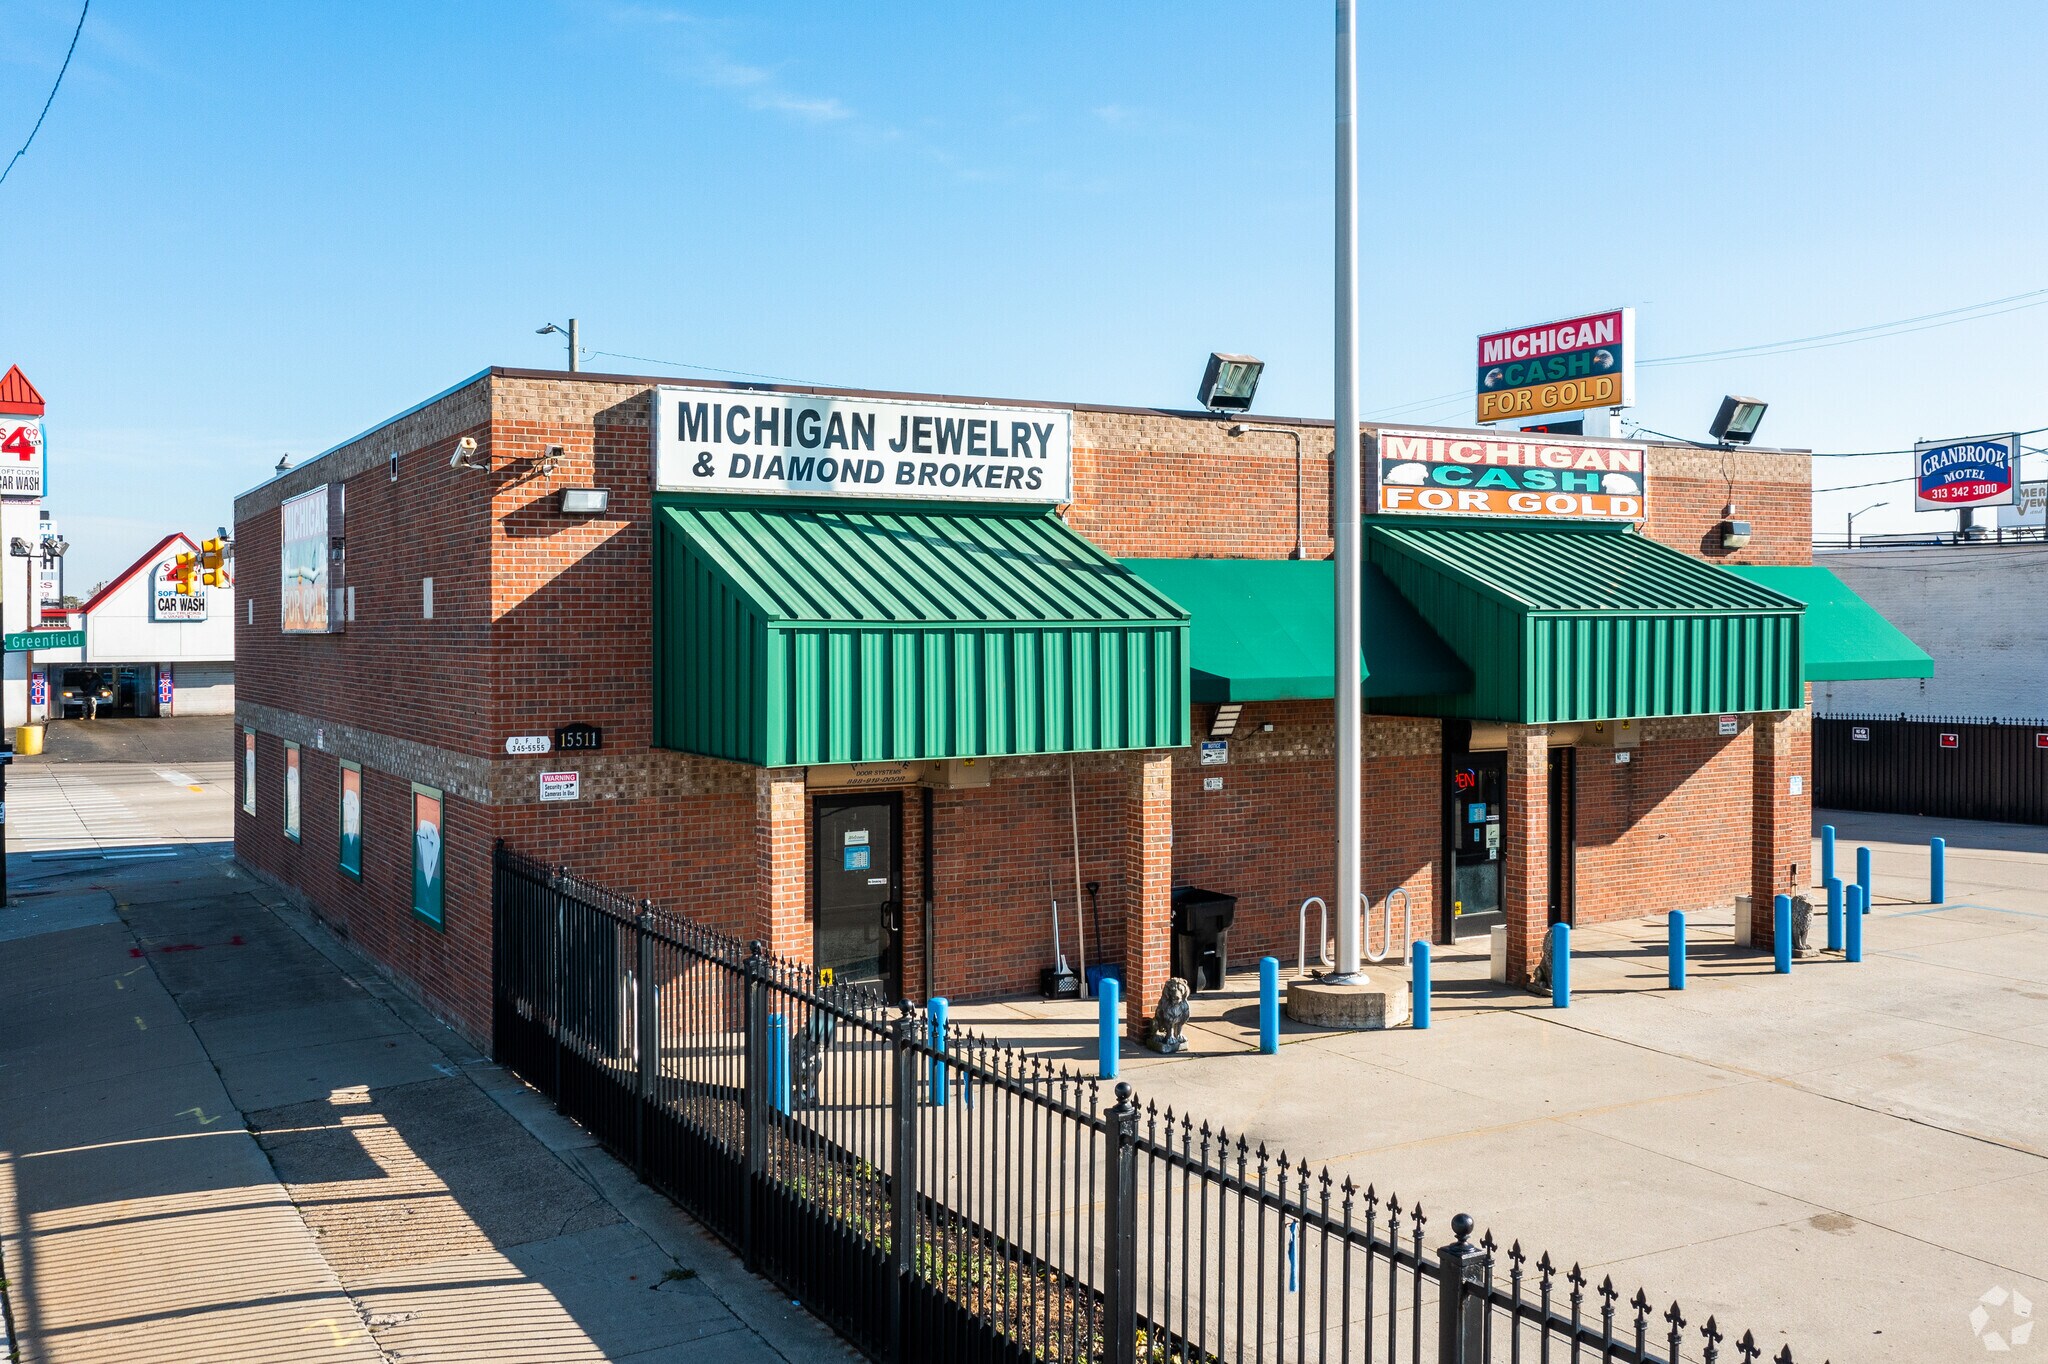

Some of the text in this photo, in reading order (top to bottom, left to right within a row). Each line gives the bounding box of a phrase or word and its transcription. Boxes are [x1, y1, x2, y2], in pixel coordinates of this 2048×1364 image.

[1484, 318, 1614, 363] MICHIGAN
[1504, 352, 1590, 386] CASH
[1483, 377, 1613, 416] FOR GOLD
[25, 428, 38, 440] 99
[678, 402, 1054, 459] MICHIGAN JEWELRY
[1386, 436, 1640, 471] MICHIGAN
[1923, 445, 2006, 476] CRANBROOK
[691, 451, 1043, 490] & DIAMOND BROKERS
[1432, 465, 1600, 492] CASH
[1944, 468, 1985, 484] MOTEL
[16, 476, 40, 491] WASH
[1932, 483, 1997, 499] 313 342 3000
[1386, 488, 1639, 516] FOR GOLD
[158, 598, 205, 611] CAR WASH
[12, 633, 79, 648] Greenfield
[33, 672, 44, 704] EXIT
[160, 671, 171, 702] EXIT
[512, 744, 546, 752] 345-5555
[561, 731, 597, 748] 15511
[543, 774, 576, 782] WARNING
[874, 768, 902, 776] SYSTEMS
[544, 783, 563, 791] Security
